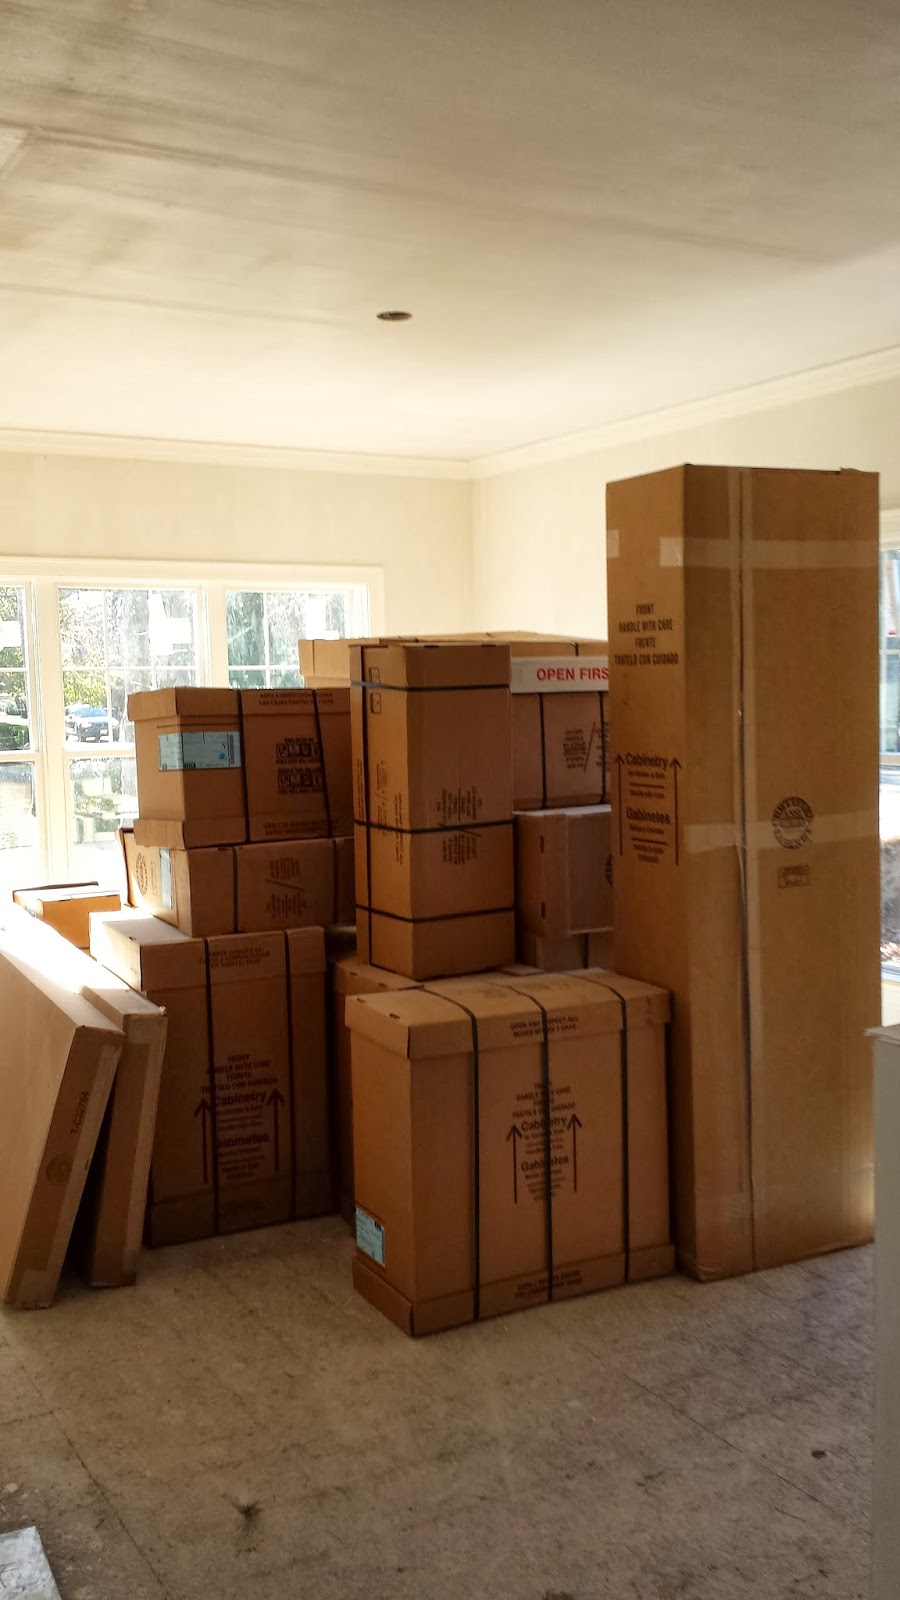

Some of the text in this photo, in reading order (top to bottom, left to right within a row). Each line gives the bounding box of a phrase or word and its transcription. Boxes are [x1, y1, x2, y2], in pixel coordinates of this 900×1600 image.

[635, 603, 655, 615] FRONT
[618, 618, 674, 633] HANDLE WITH CARE
[536, 666, 609, 681] OPEN FIRS
[625, 752, 668, 771] Cabinetry
[626, 807, 671, 825] Gabinetes
